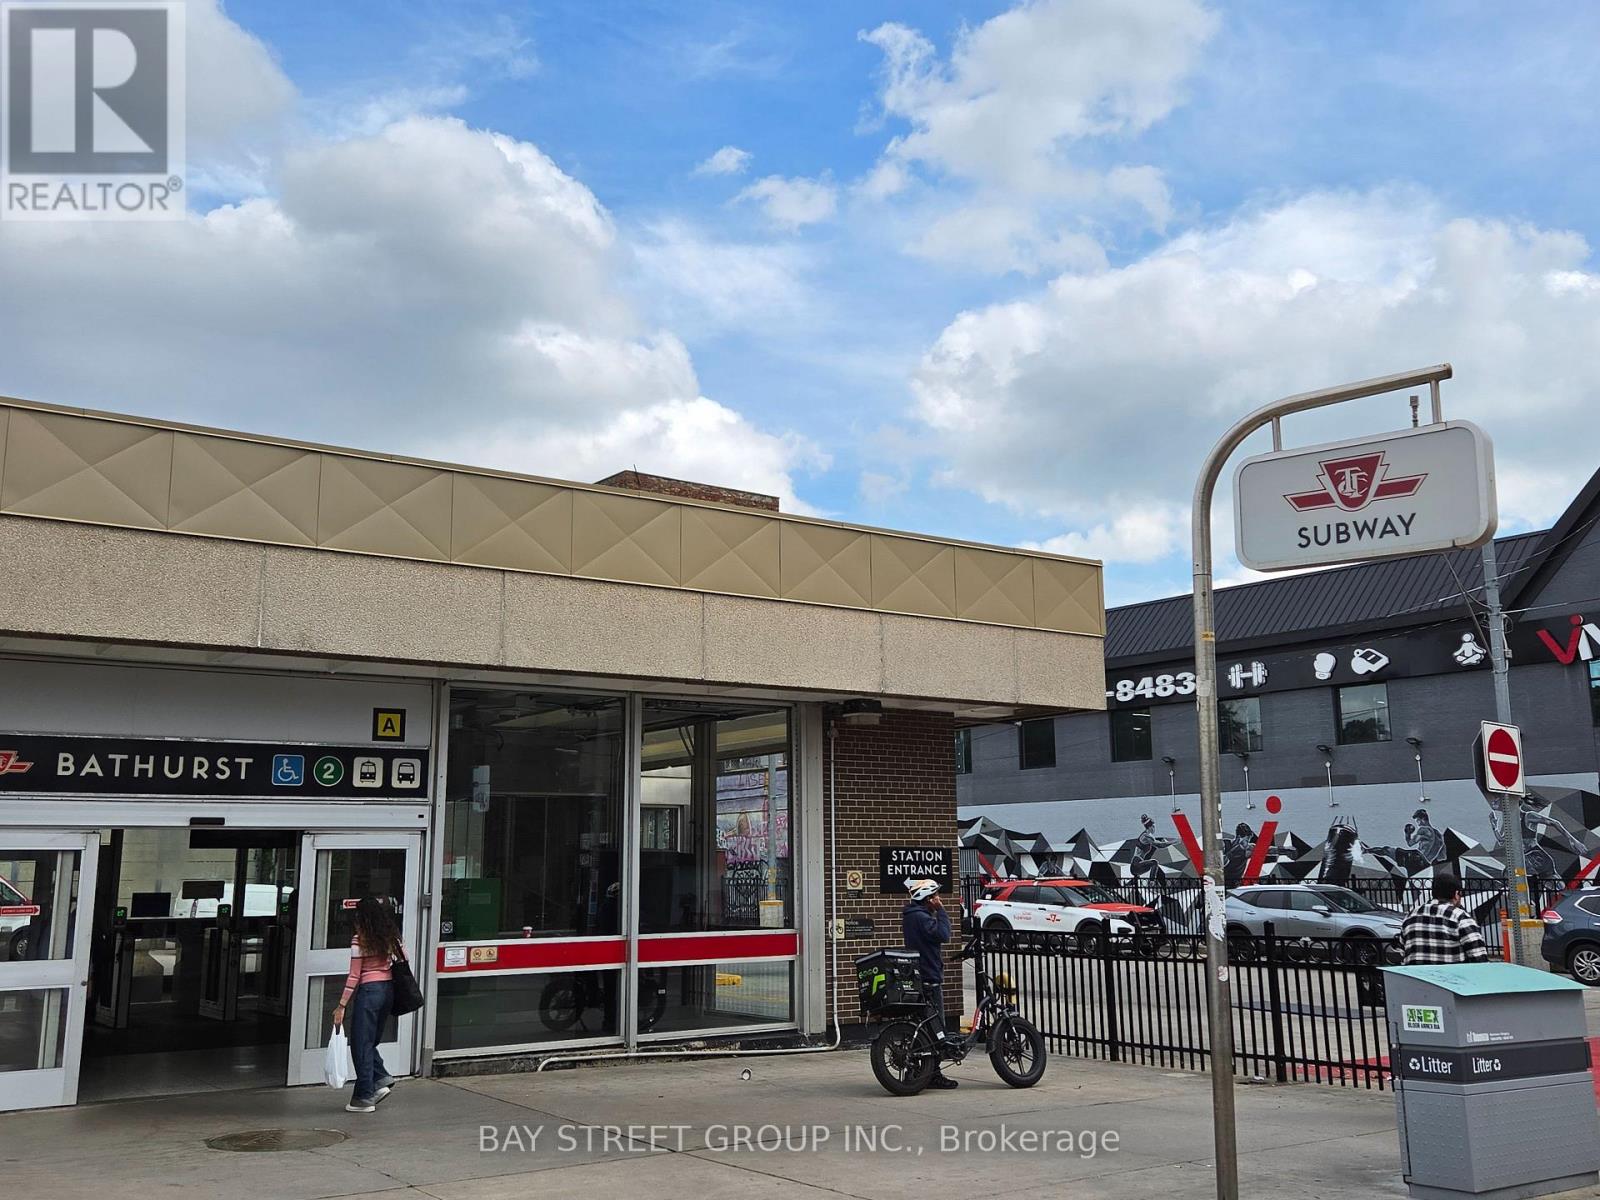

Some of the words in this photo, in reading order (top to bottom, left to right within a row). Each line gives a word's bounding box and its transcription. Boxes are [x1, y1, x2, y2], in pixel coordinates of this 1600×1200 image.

[1297, 512, 1417, 549] SUBWAY
[381, 716, 396, 733] A
[57, 752, 255, 782] BATHURST
[891, 850, 943, 862] STATION
[887, 864, 948, 876] ENTRANCE
[1421, 1056, 1453, 1075] Litter
[1472, 1057, 1493, 1074] Litter
